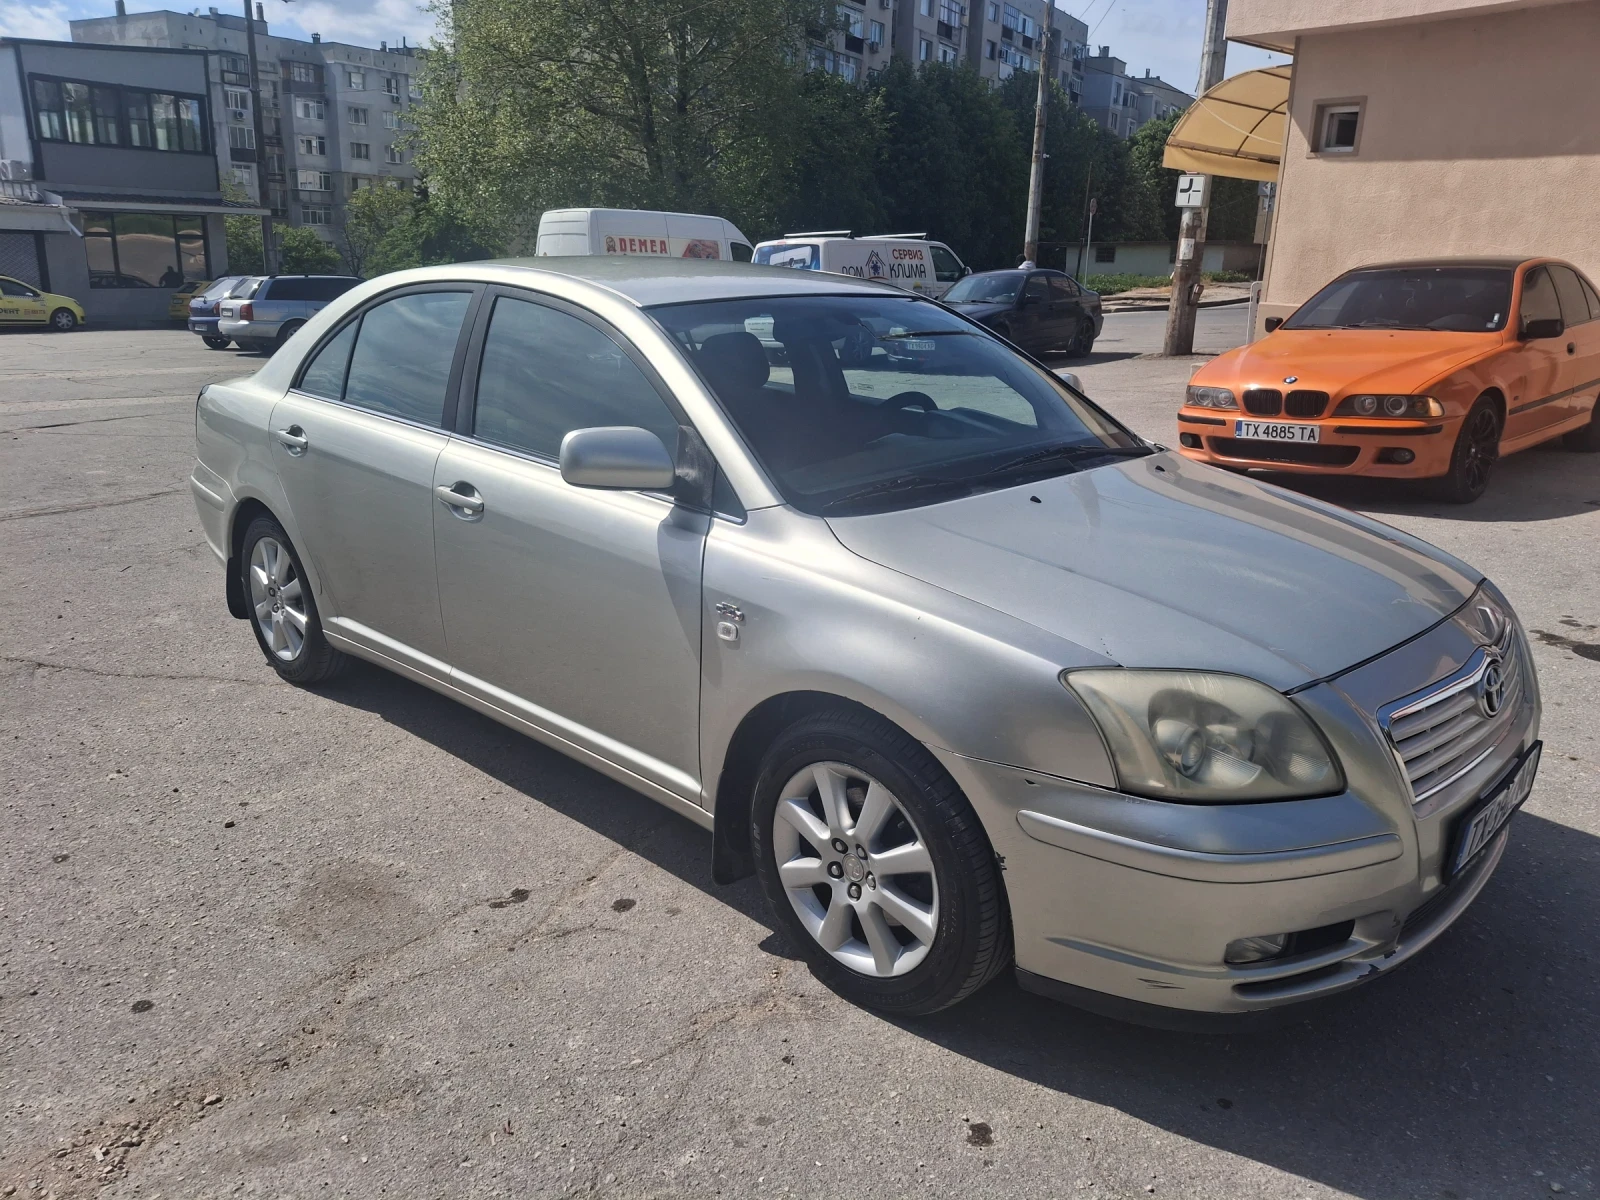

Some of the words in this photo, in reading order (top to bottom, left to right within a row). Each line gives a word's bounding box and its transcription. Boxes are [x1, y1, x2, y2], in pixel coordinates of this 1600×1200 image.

[892, 249, 924, 260] СЕРВИЗ
[1244, 423, 1260, 437] TX
[1263, 424, 1295, 439] 4885
[1299, 427, 1316, 441] TA
